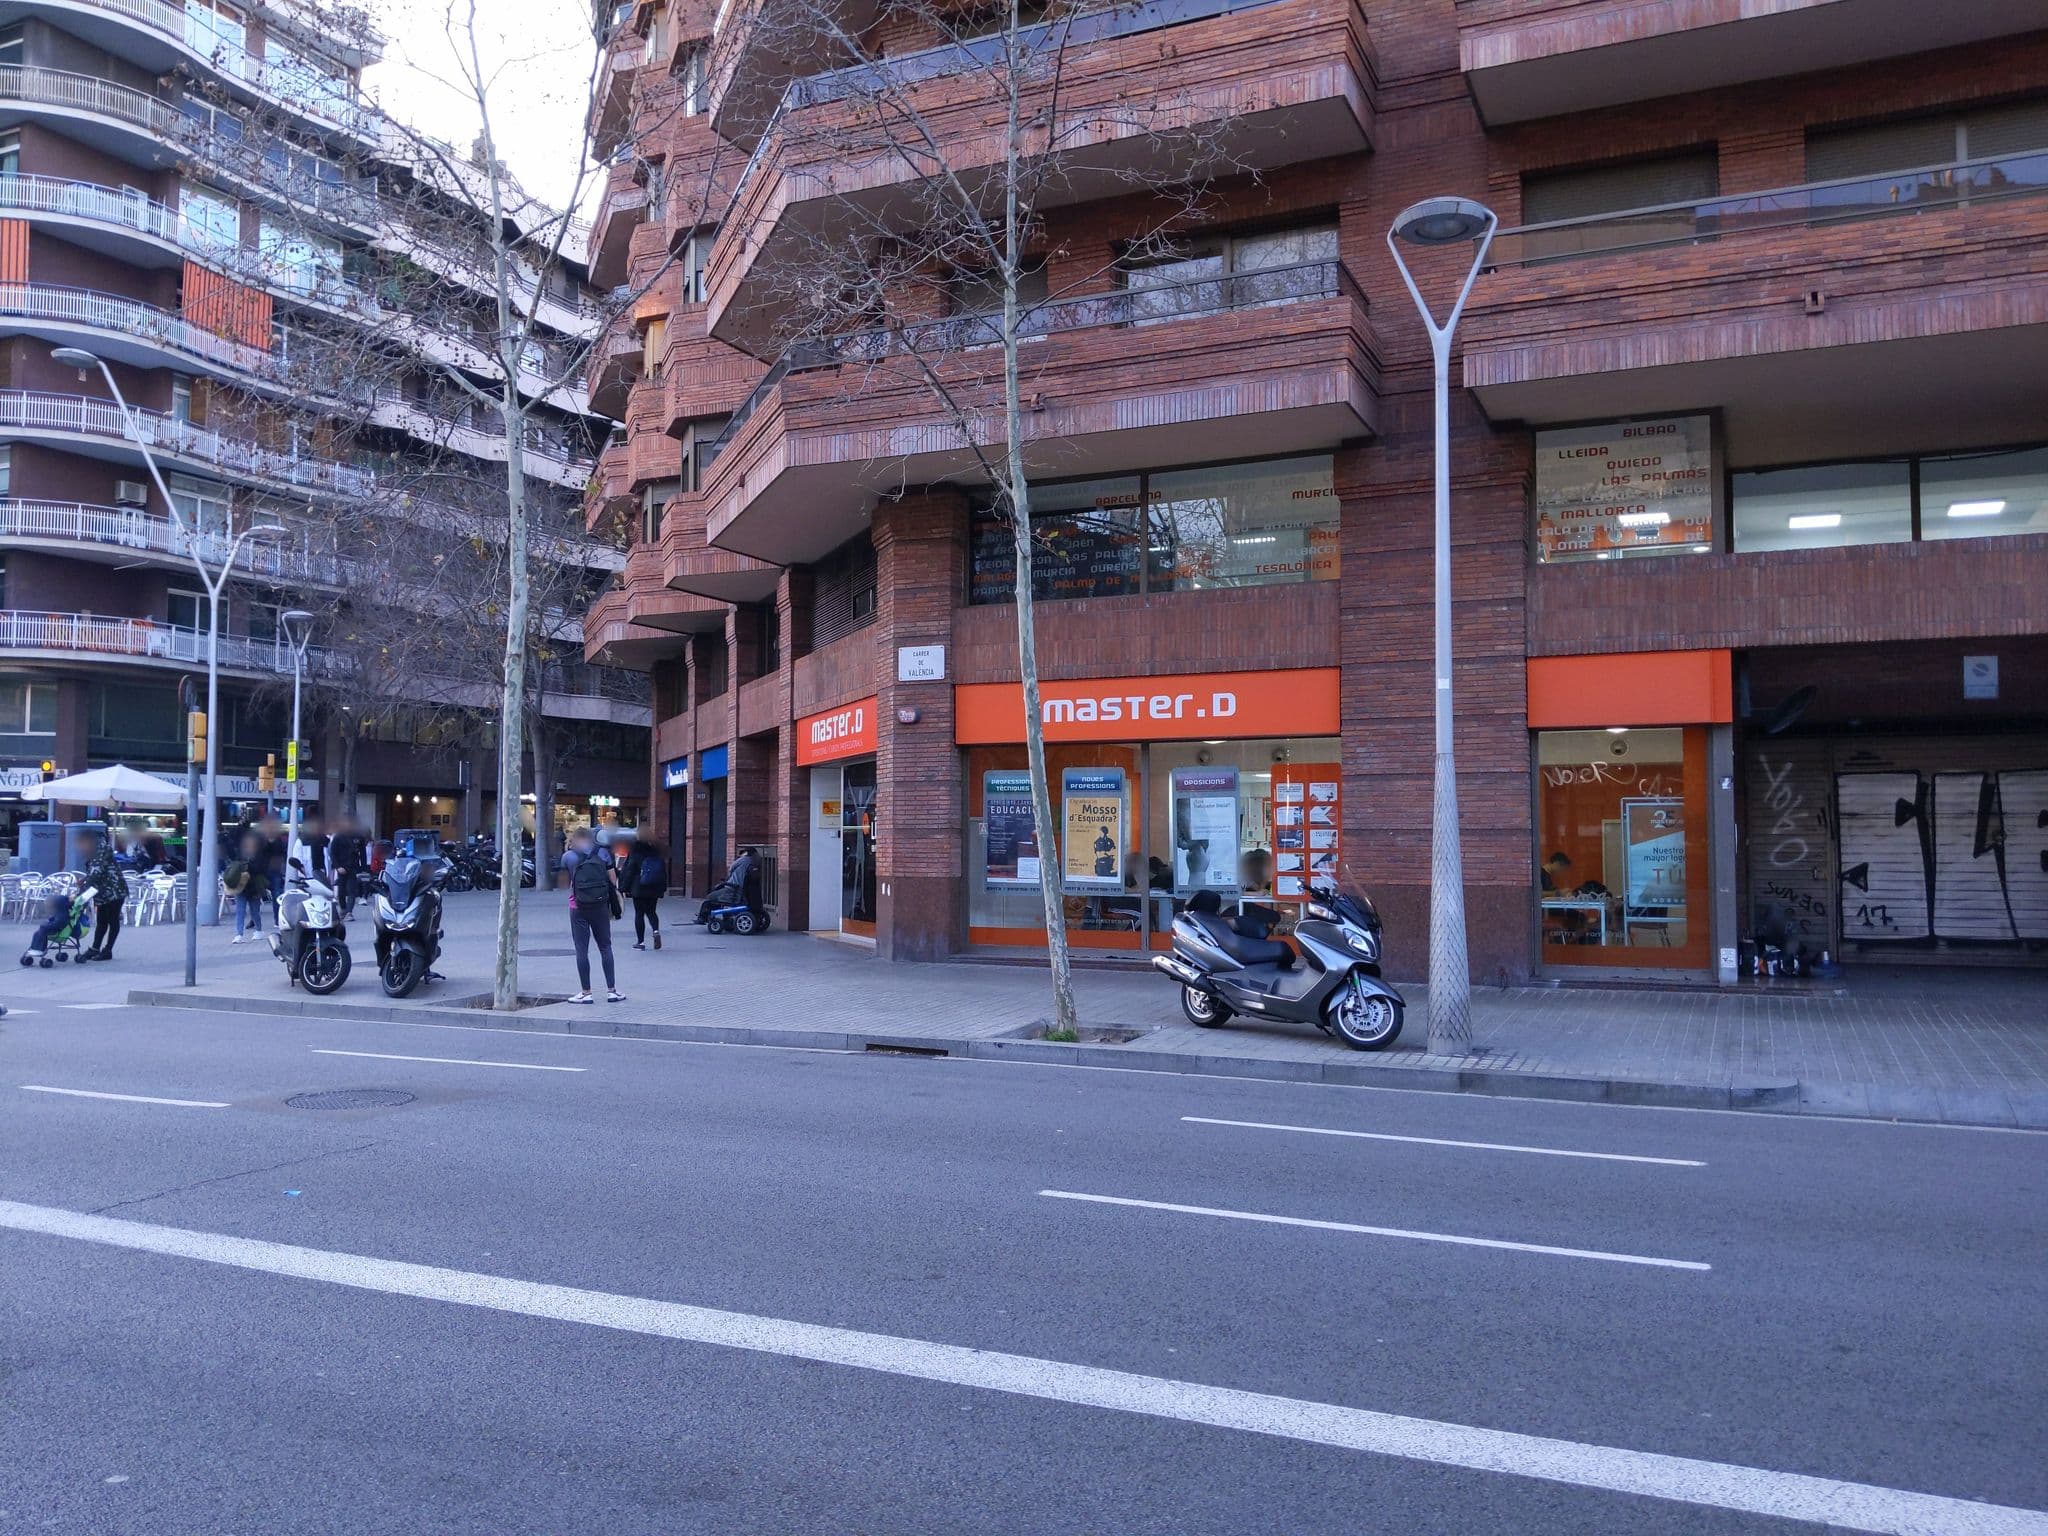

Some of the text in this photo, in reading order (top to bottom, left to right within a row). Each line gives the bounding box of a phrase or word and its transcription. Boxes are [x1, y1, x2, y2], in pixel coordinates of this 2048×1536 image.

[1623, 424, 1677, 438] BILBAO
[1558, 446, 1609, 459] LLEIDA
[1602, 468, 1707, 486] LAS PALMAS
[1291, 487, 1337, 500] MURCI
[1561, 504, 1646, 520] MALLORCA
[990, 805, 1031, 815] EDUCACI
[1082, 804, 1117, 815] Mosso
[1652, 847, 1684, 855] Nuestro
[1643, 855, 1669, 863] mayor
